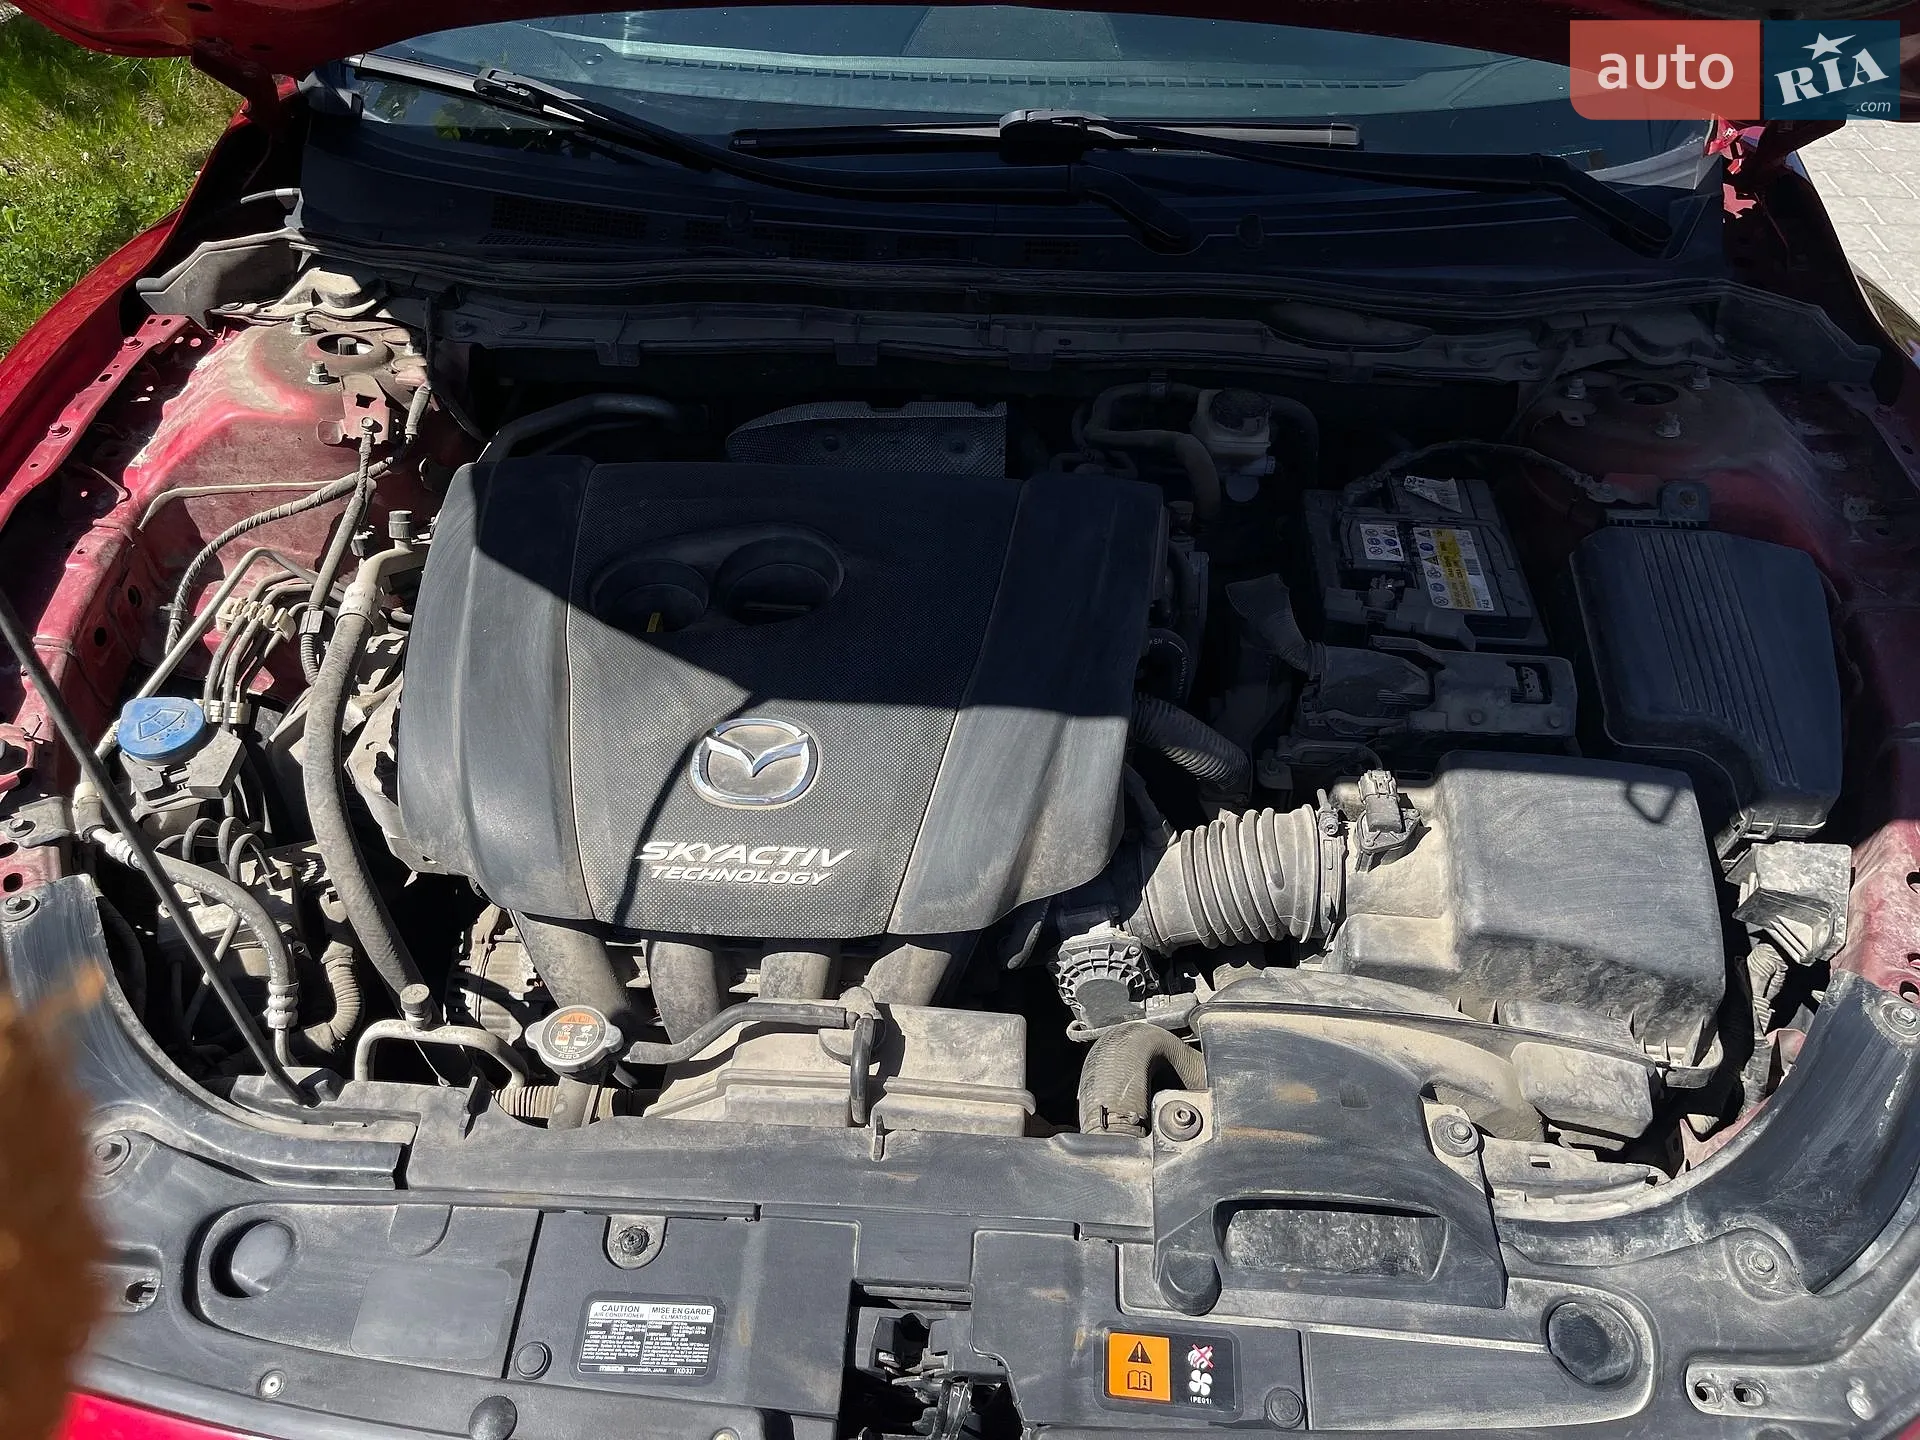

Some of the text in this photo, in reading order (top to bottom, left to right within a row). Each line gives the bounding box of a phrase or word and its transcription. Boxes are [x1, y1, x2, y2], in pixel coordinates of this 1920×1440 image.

[635, 841, 857, 868] SKYACTIV
[651, 866, 833, 886] TECHNOLOGY
[601, 1304, 640, 1313] CAUTION
